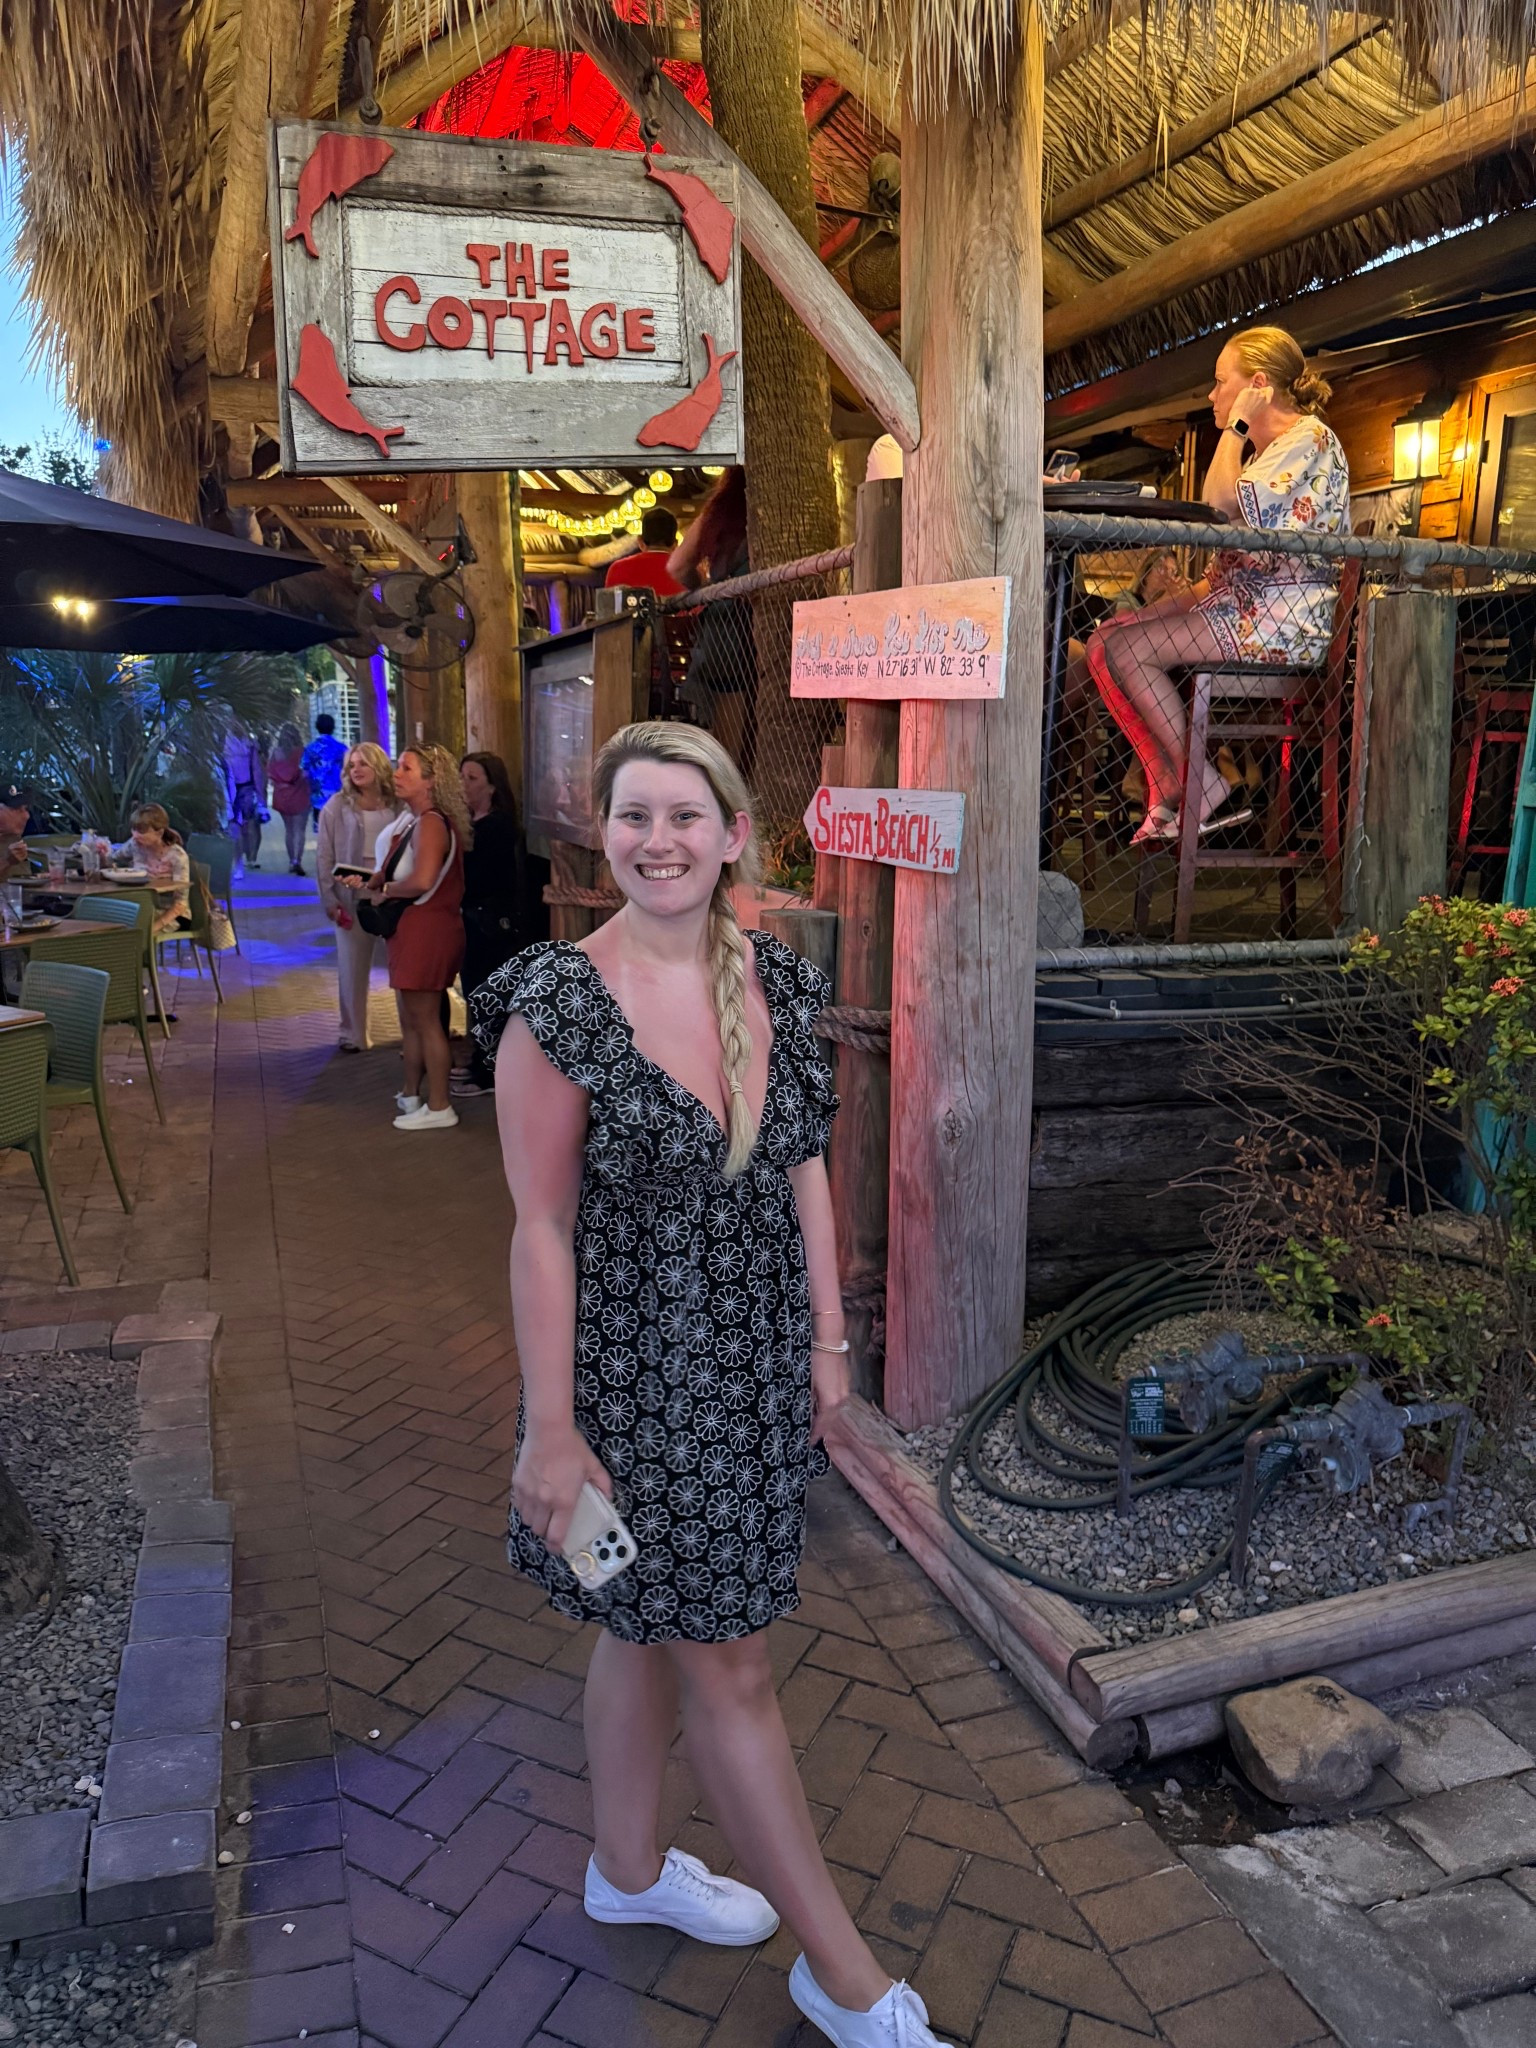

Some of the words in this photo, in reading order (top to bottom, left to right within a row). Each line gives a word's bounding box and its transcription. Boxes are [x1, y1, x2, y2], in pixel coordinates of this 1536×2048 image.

[466, 241, 569, 298] THE
[374, 275, 656, 374] COTTAGE
[877, 659, 884, 678] N
[924, 656, 936, 675] W
[877, 797, 930, 865] BEACH
